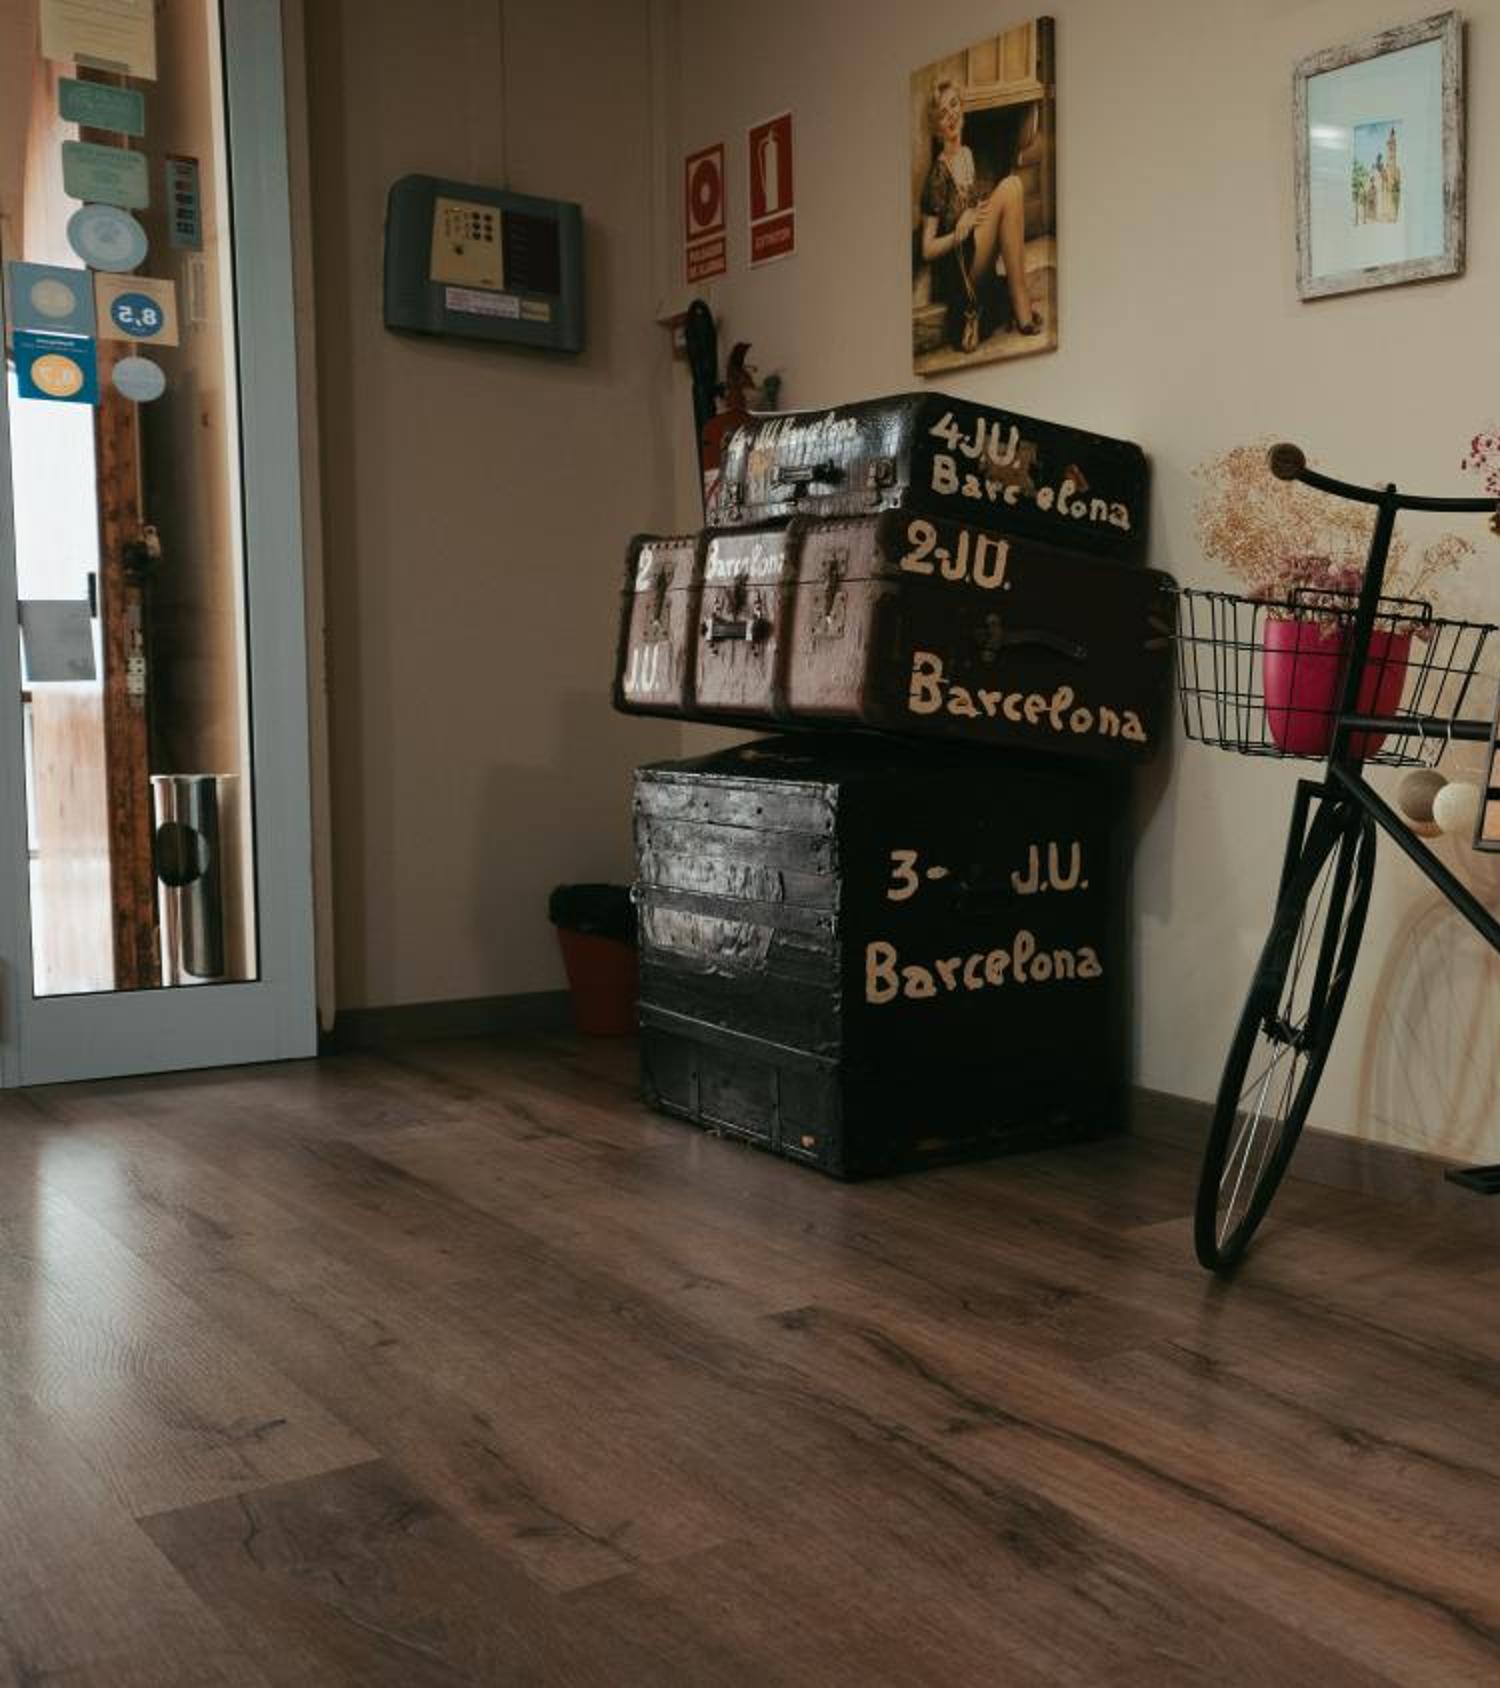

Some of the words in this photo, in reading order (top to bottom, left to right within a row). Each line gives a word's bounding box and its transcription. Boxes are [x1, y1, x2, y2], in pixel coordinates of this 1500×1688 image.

[908, 651, 1147, 742] Barcelona
[1011, 842, 1089, 894] J.U.
[866, 930, 1103, 1004] Barcelona
